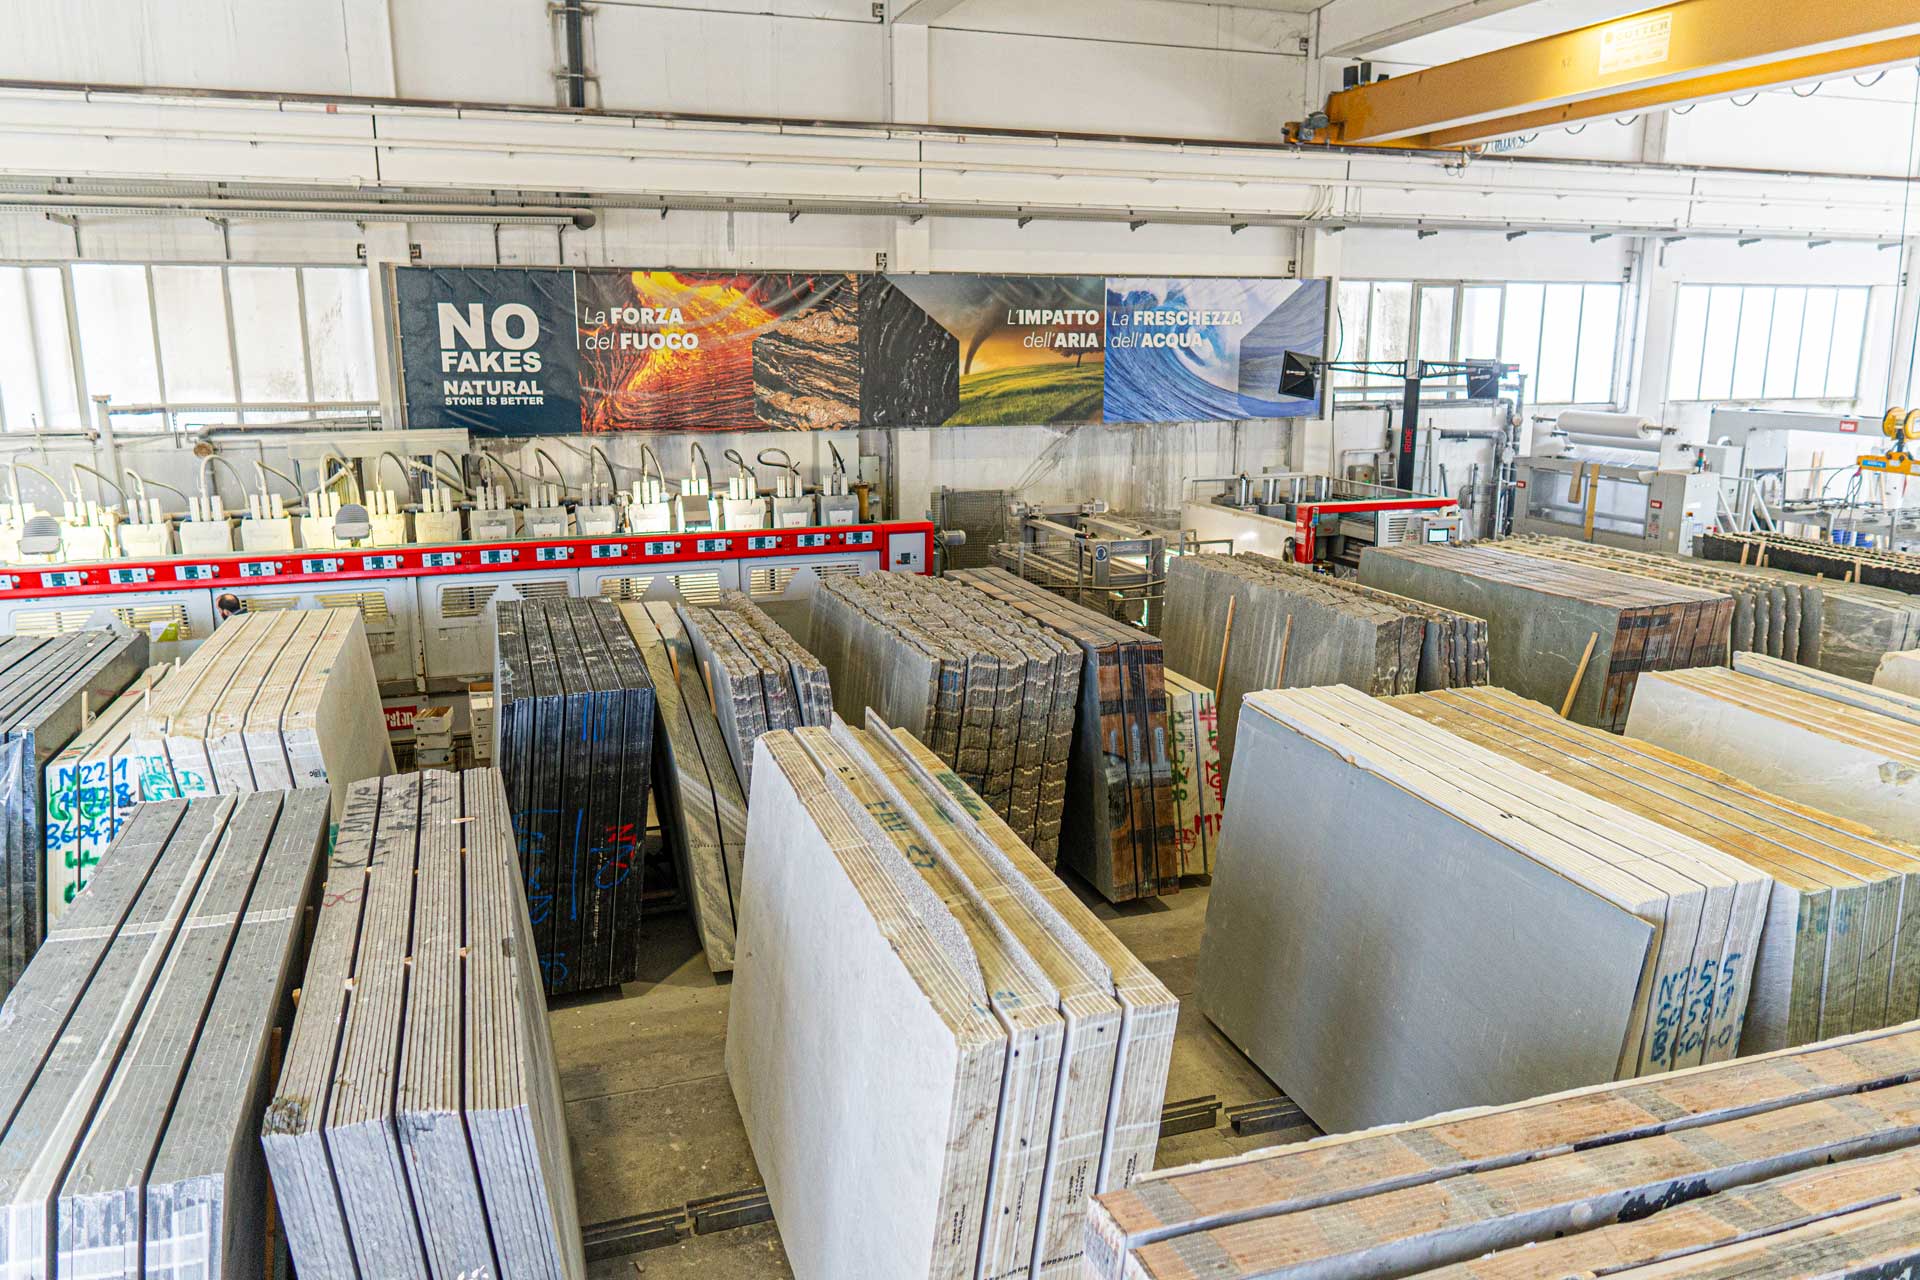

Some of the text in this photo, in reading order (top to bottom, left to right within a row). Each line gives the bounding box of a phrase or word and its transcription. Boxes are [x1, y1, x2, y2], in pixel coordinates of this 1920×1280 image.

[584, 306, 684, 325] La FORZA
[1007, 309, 1100, 326] L'IMPATTO
[1111, 310, 1243, 326] La FRESCHEZZA
[437, 303, 540, 350] NO
[585, 331, 699, 350] del FUOCO
[1023, 331, 1099, 348] dell'ARIA
[1110, 331, 1203, 349] dell'ACQUA
[441, 351, 542, 373] FAKES
[443, 380, 544, 395] NATURAL
[445, 396, 544, 406] STONE IS BETTER
